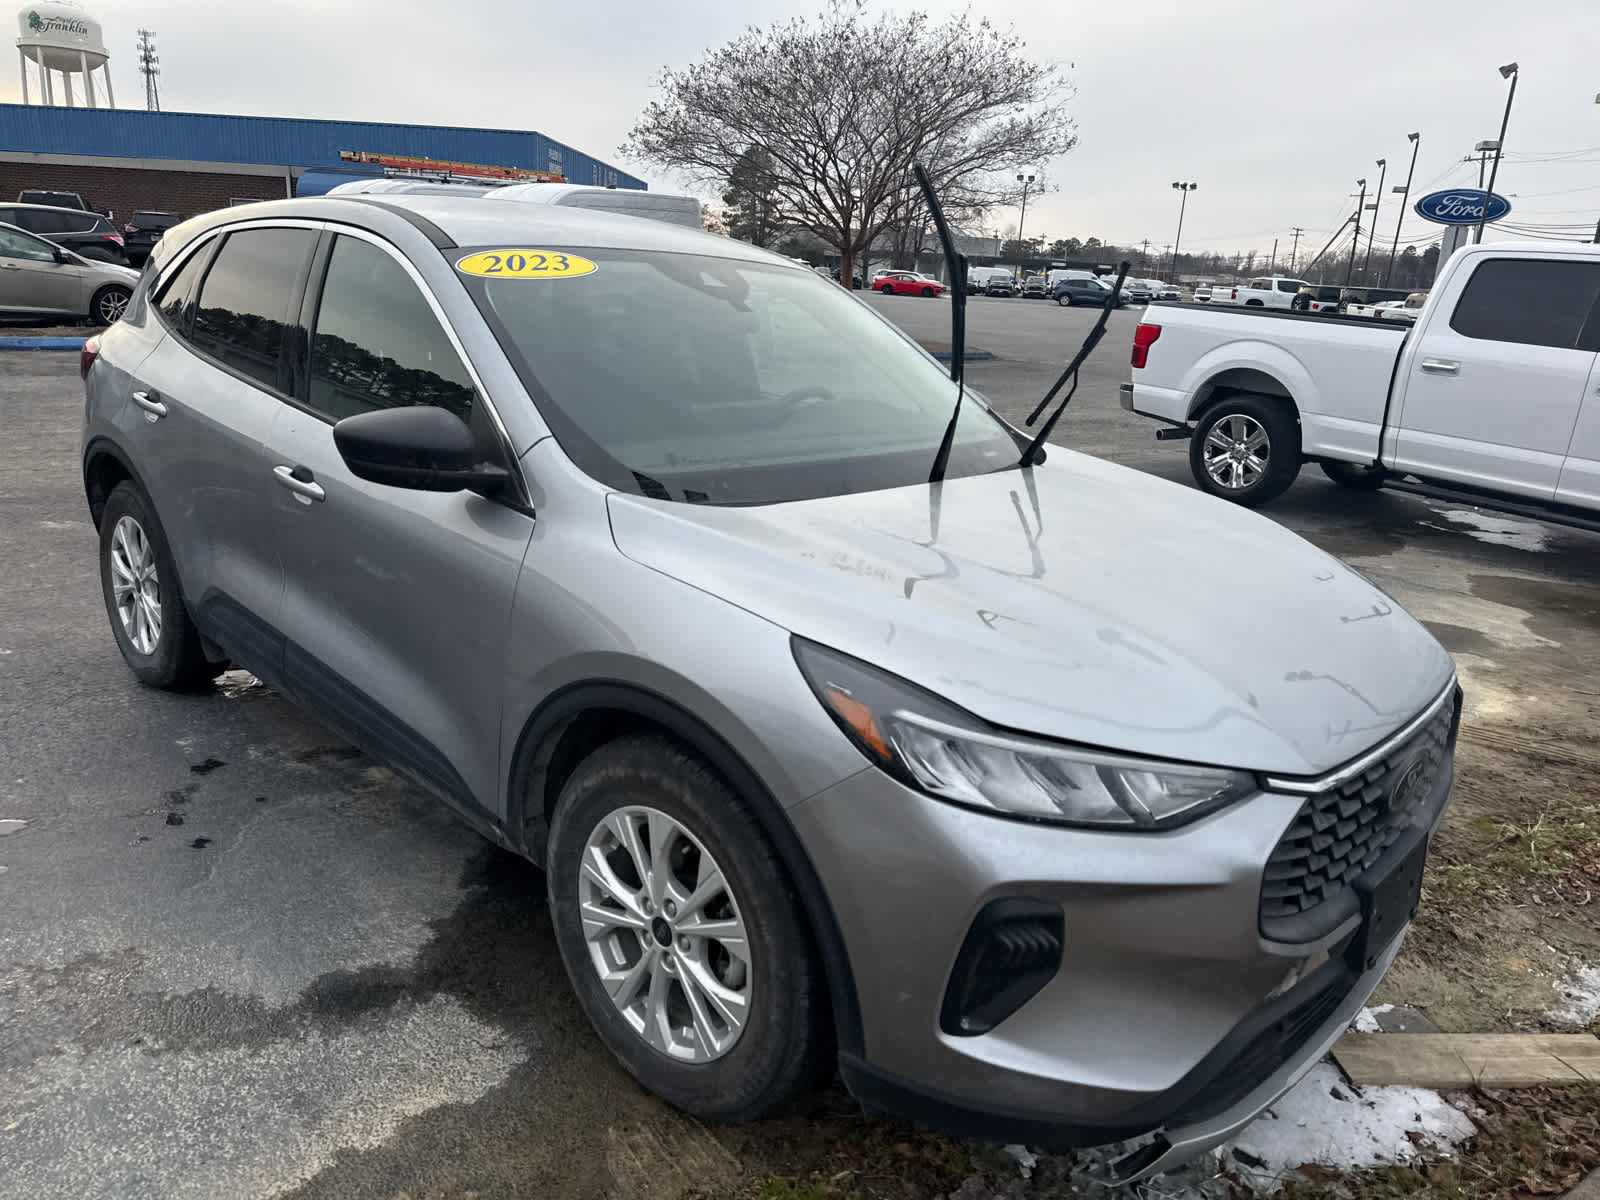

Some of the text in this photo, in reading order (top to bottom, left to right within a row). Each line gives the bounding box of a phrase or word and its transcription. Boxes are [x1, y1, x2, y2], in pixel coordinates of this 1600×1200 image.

[38, 17, 88, 34] Franklin
[1435, 195, 1491, 217] Ford
[483, 254, 570, 273] 2023
